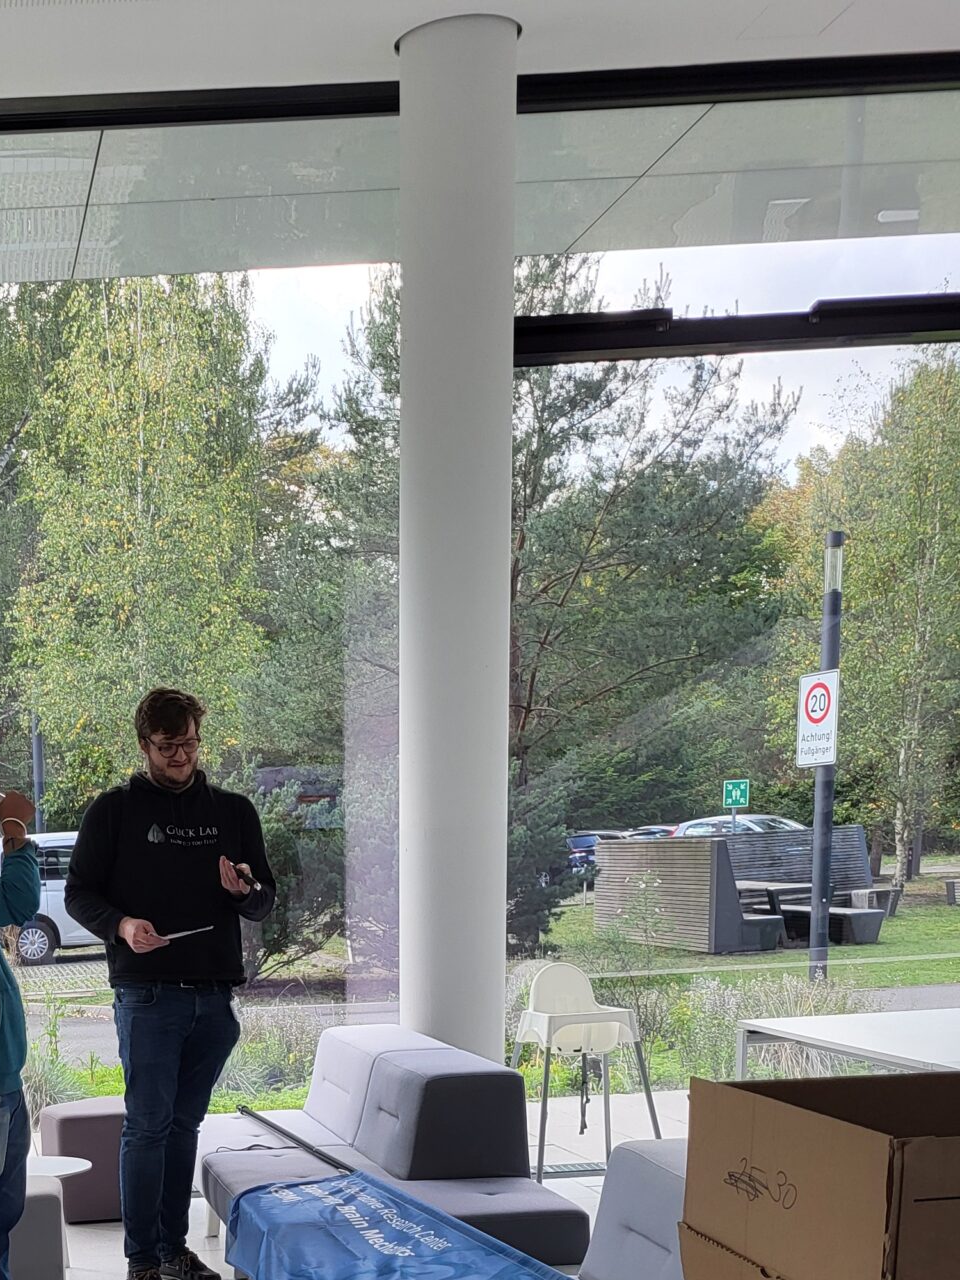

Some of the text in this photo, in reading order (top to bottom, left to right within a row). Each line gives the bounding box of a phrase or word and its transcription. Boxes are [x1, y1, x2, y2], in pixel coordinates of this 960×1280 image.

[810, 693, 826, 713] 20
[801, 730, 833, 743] Achtung!
[800, 745, 832, 757] Fußgänger
[768, 1171, 798, 1210] 30
[336, 1205, 369, 1229] Brain
[377, 1208, 424, 1237] Research
[415, 1230, 452, 1251] Center
